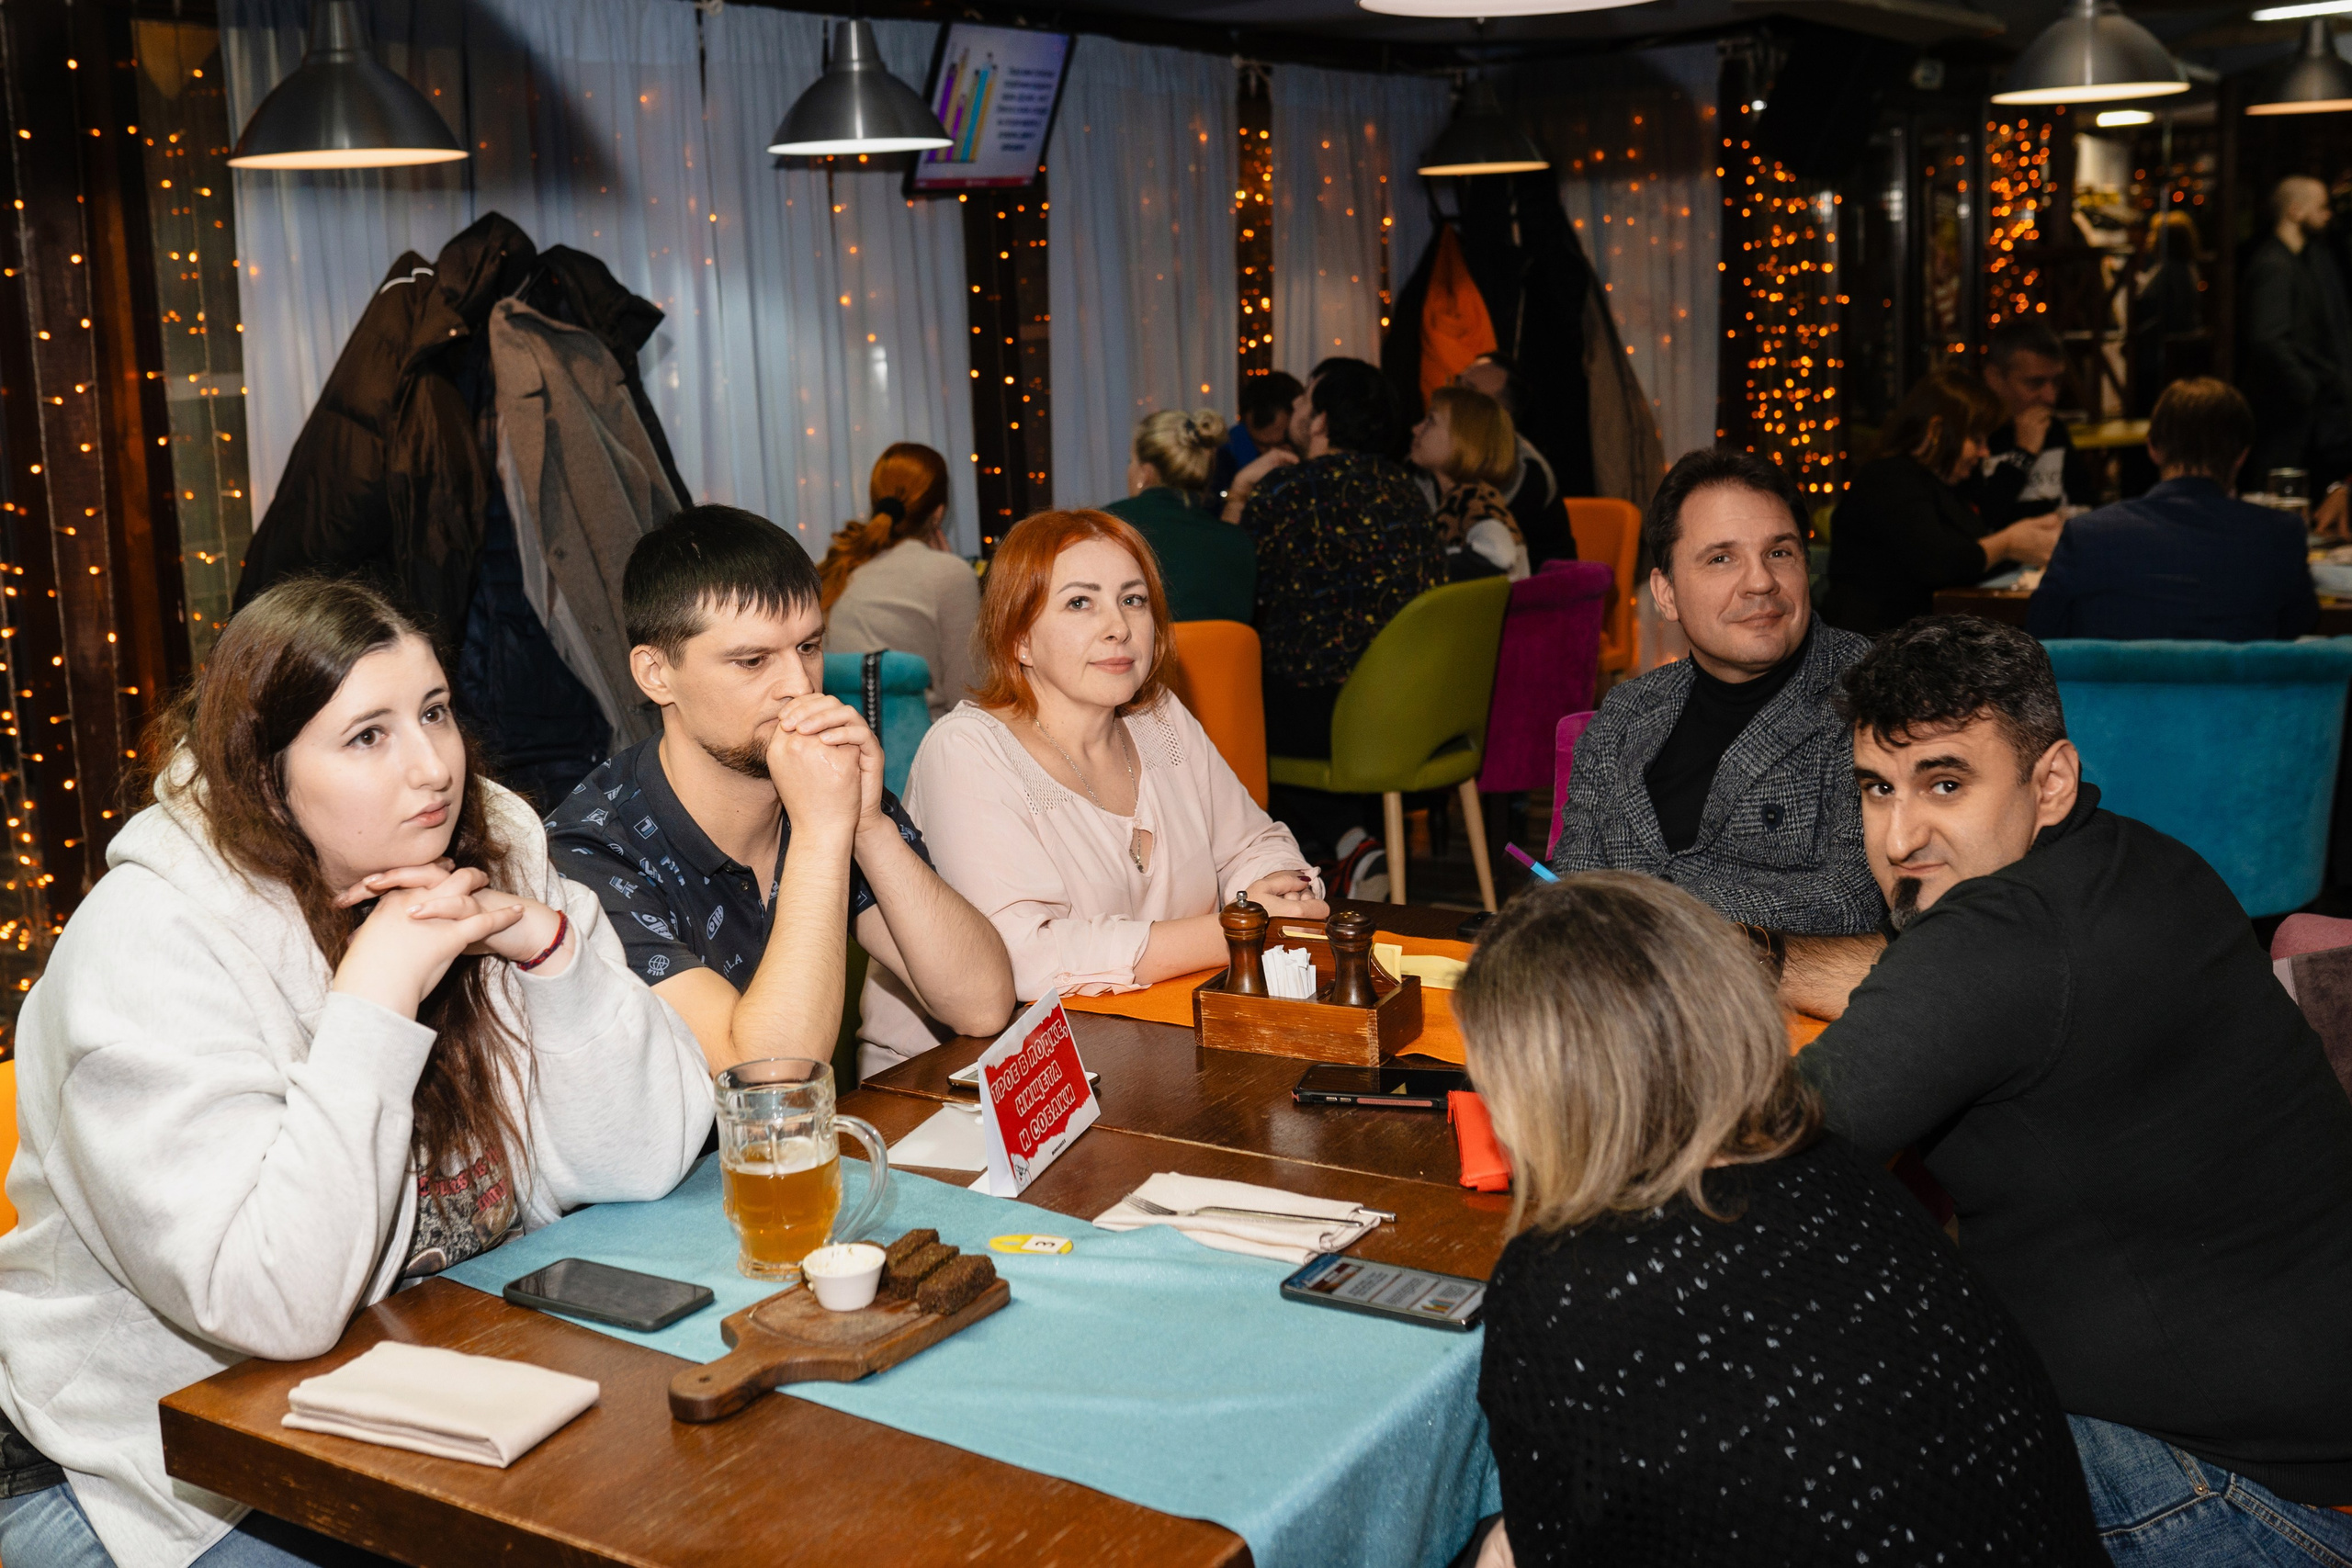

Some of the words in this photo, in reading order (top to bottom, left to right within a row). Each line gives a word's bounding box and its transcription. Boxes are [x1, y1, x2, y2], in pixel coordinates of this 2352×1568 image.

[990, 1062, 1020, 1104] ТРОЕ
[1018, 1055, 1029, 1077] В
[1014, 1060, 1063, 1117] НИЩЕТА
[1019, 1131, 1032, 1152] И
[1030, 1083, 1076, 1141] СОБАКИ
